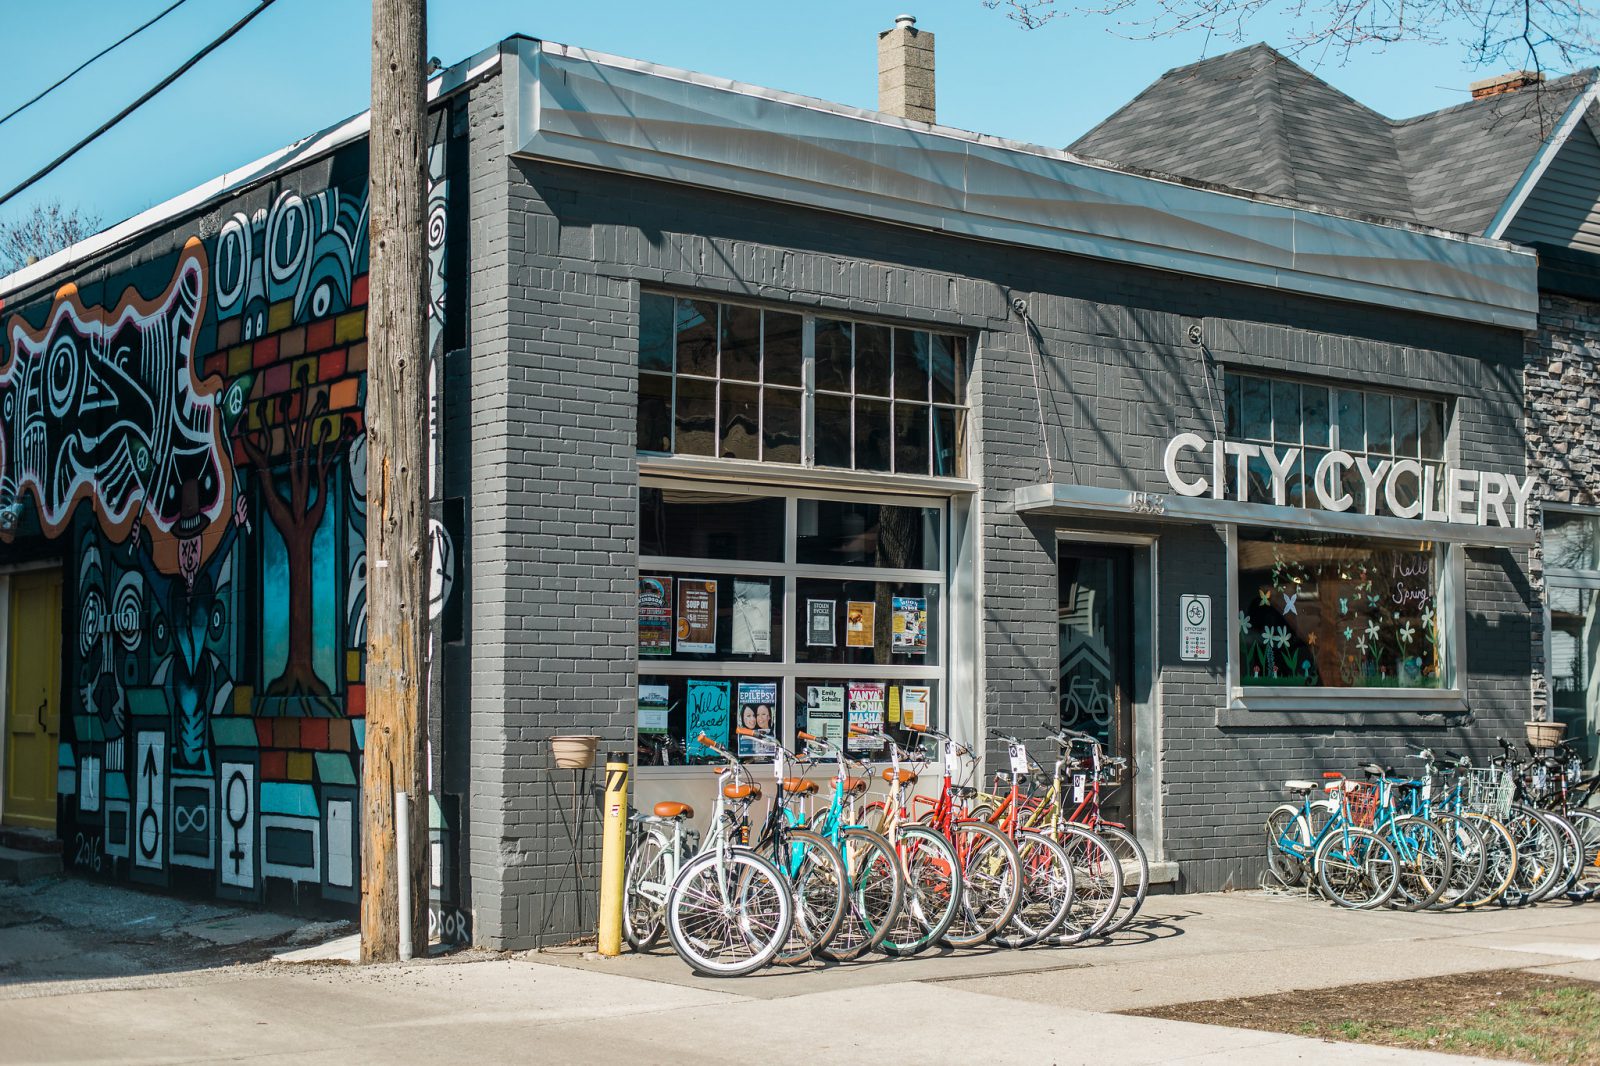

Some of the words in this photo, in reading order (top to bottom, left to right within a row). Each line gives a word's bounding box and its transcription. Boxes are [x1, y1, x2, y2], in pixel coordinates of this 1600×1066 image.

[1164, 432, 1300, 506] CITY
[1314, 450, 1538, 529] CYCLERY
[1392, 550, 1428, 579] Hello
[739, 692, 775, 700] EPILEPSY
[821, 689, 837, 697] Emily
[850, 690, 879, 700] VANYA
[691, 692, 726, 714] Wild
[821, 695, 841, 703] Schultz
[856, 701, 884, 711] SONIA
[850, 712, 880, 722] MASHA
[74, 831, 101, 873] 2016
[428, 908, 470, 943] DSOR
